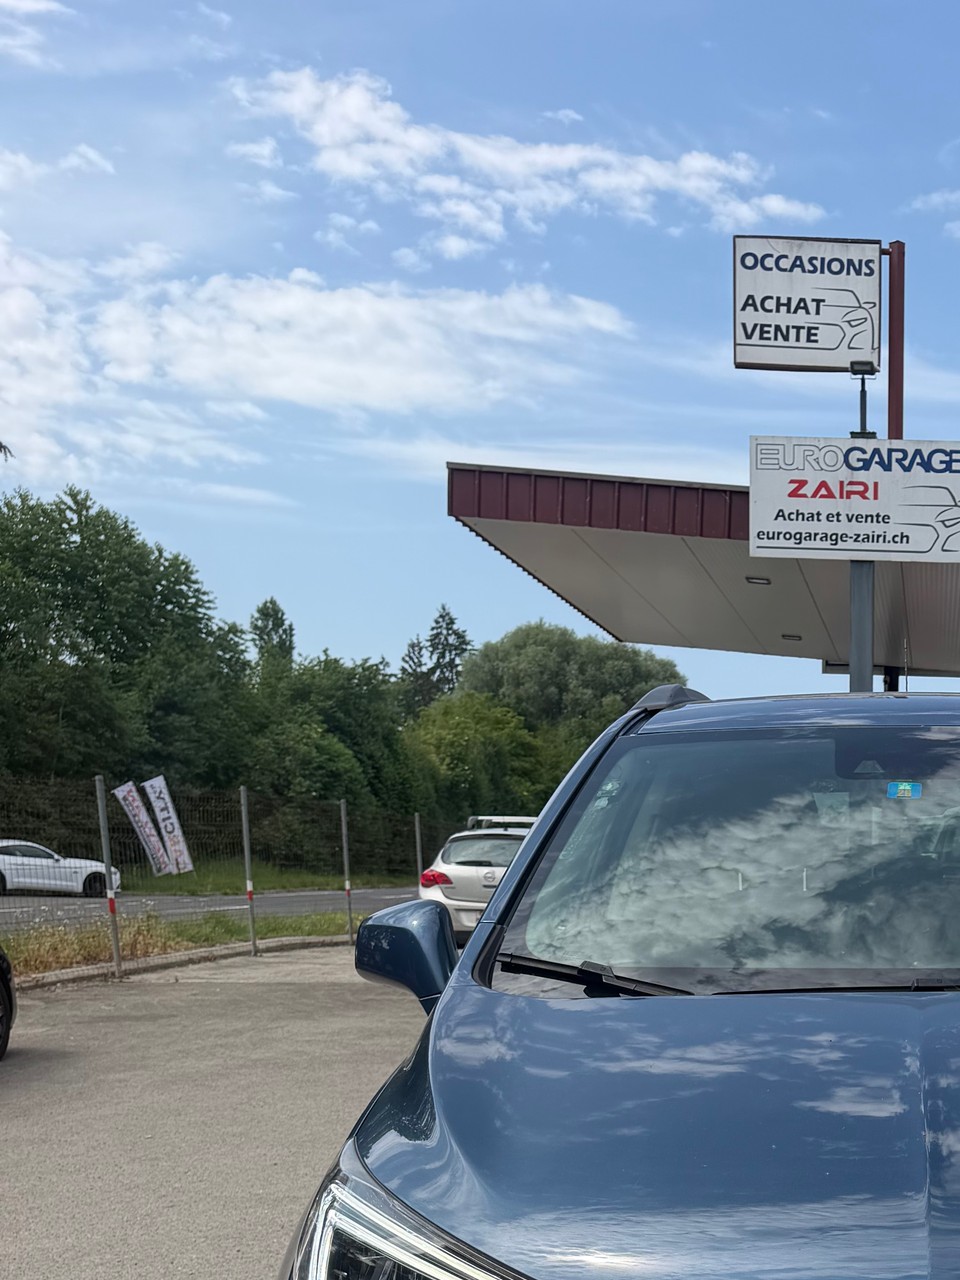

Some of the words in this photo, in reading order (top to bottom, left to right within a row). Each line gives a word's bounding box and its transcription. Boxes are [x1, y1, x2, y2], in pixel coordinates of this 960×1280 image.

[740, 252, 875, 277] OCCASIONS
[740, 294, 826, 316] ACHAT
[740, 322, 820, 344] VENTE
[787, 479, 879, 500] ZAIRI
[774, 508, 823, 522] Achat
[825, 511, 841, 523] et
[845, 512, 891, 524] vente
[756, 530, 910, 546] eurogarage-zairi.ch
